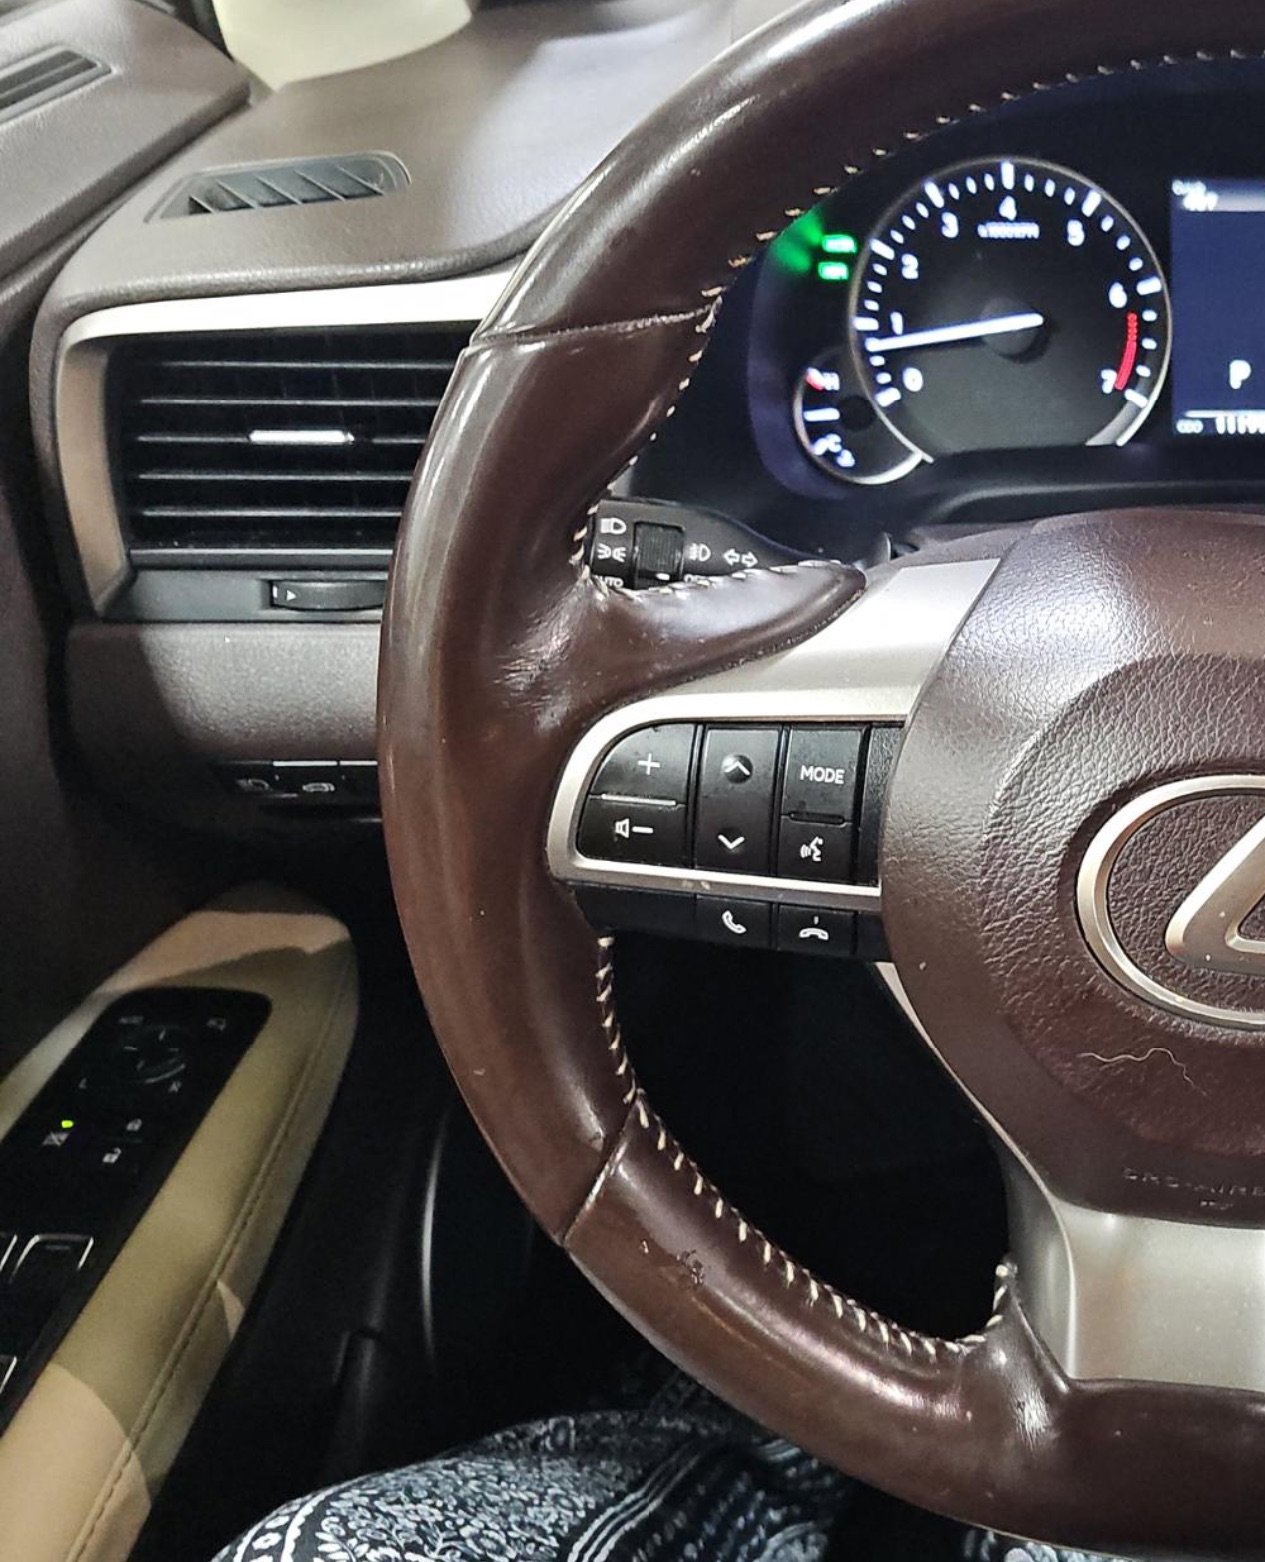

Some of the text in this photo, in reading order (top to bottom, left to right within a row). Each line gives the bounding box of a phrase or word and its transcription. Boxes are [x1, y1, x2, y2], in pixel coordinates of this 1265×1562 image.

[1000, 196, 1016, 220] 4
[942, 212, 958, 238] 3
[1067, 219, 1085, 246] 5
[902, 254, 918, 279] 2
[903, 368, 923, 392] 0
[1229, 360, 1251, 389] P
[800, 765, 846, 785] MODE
